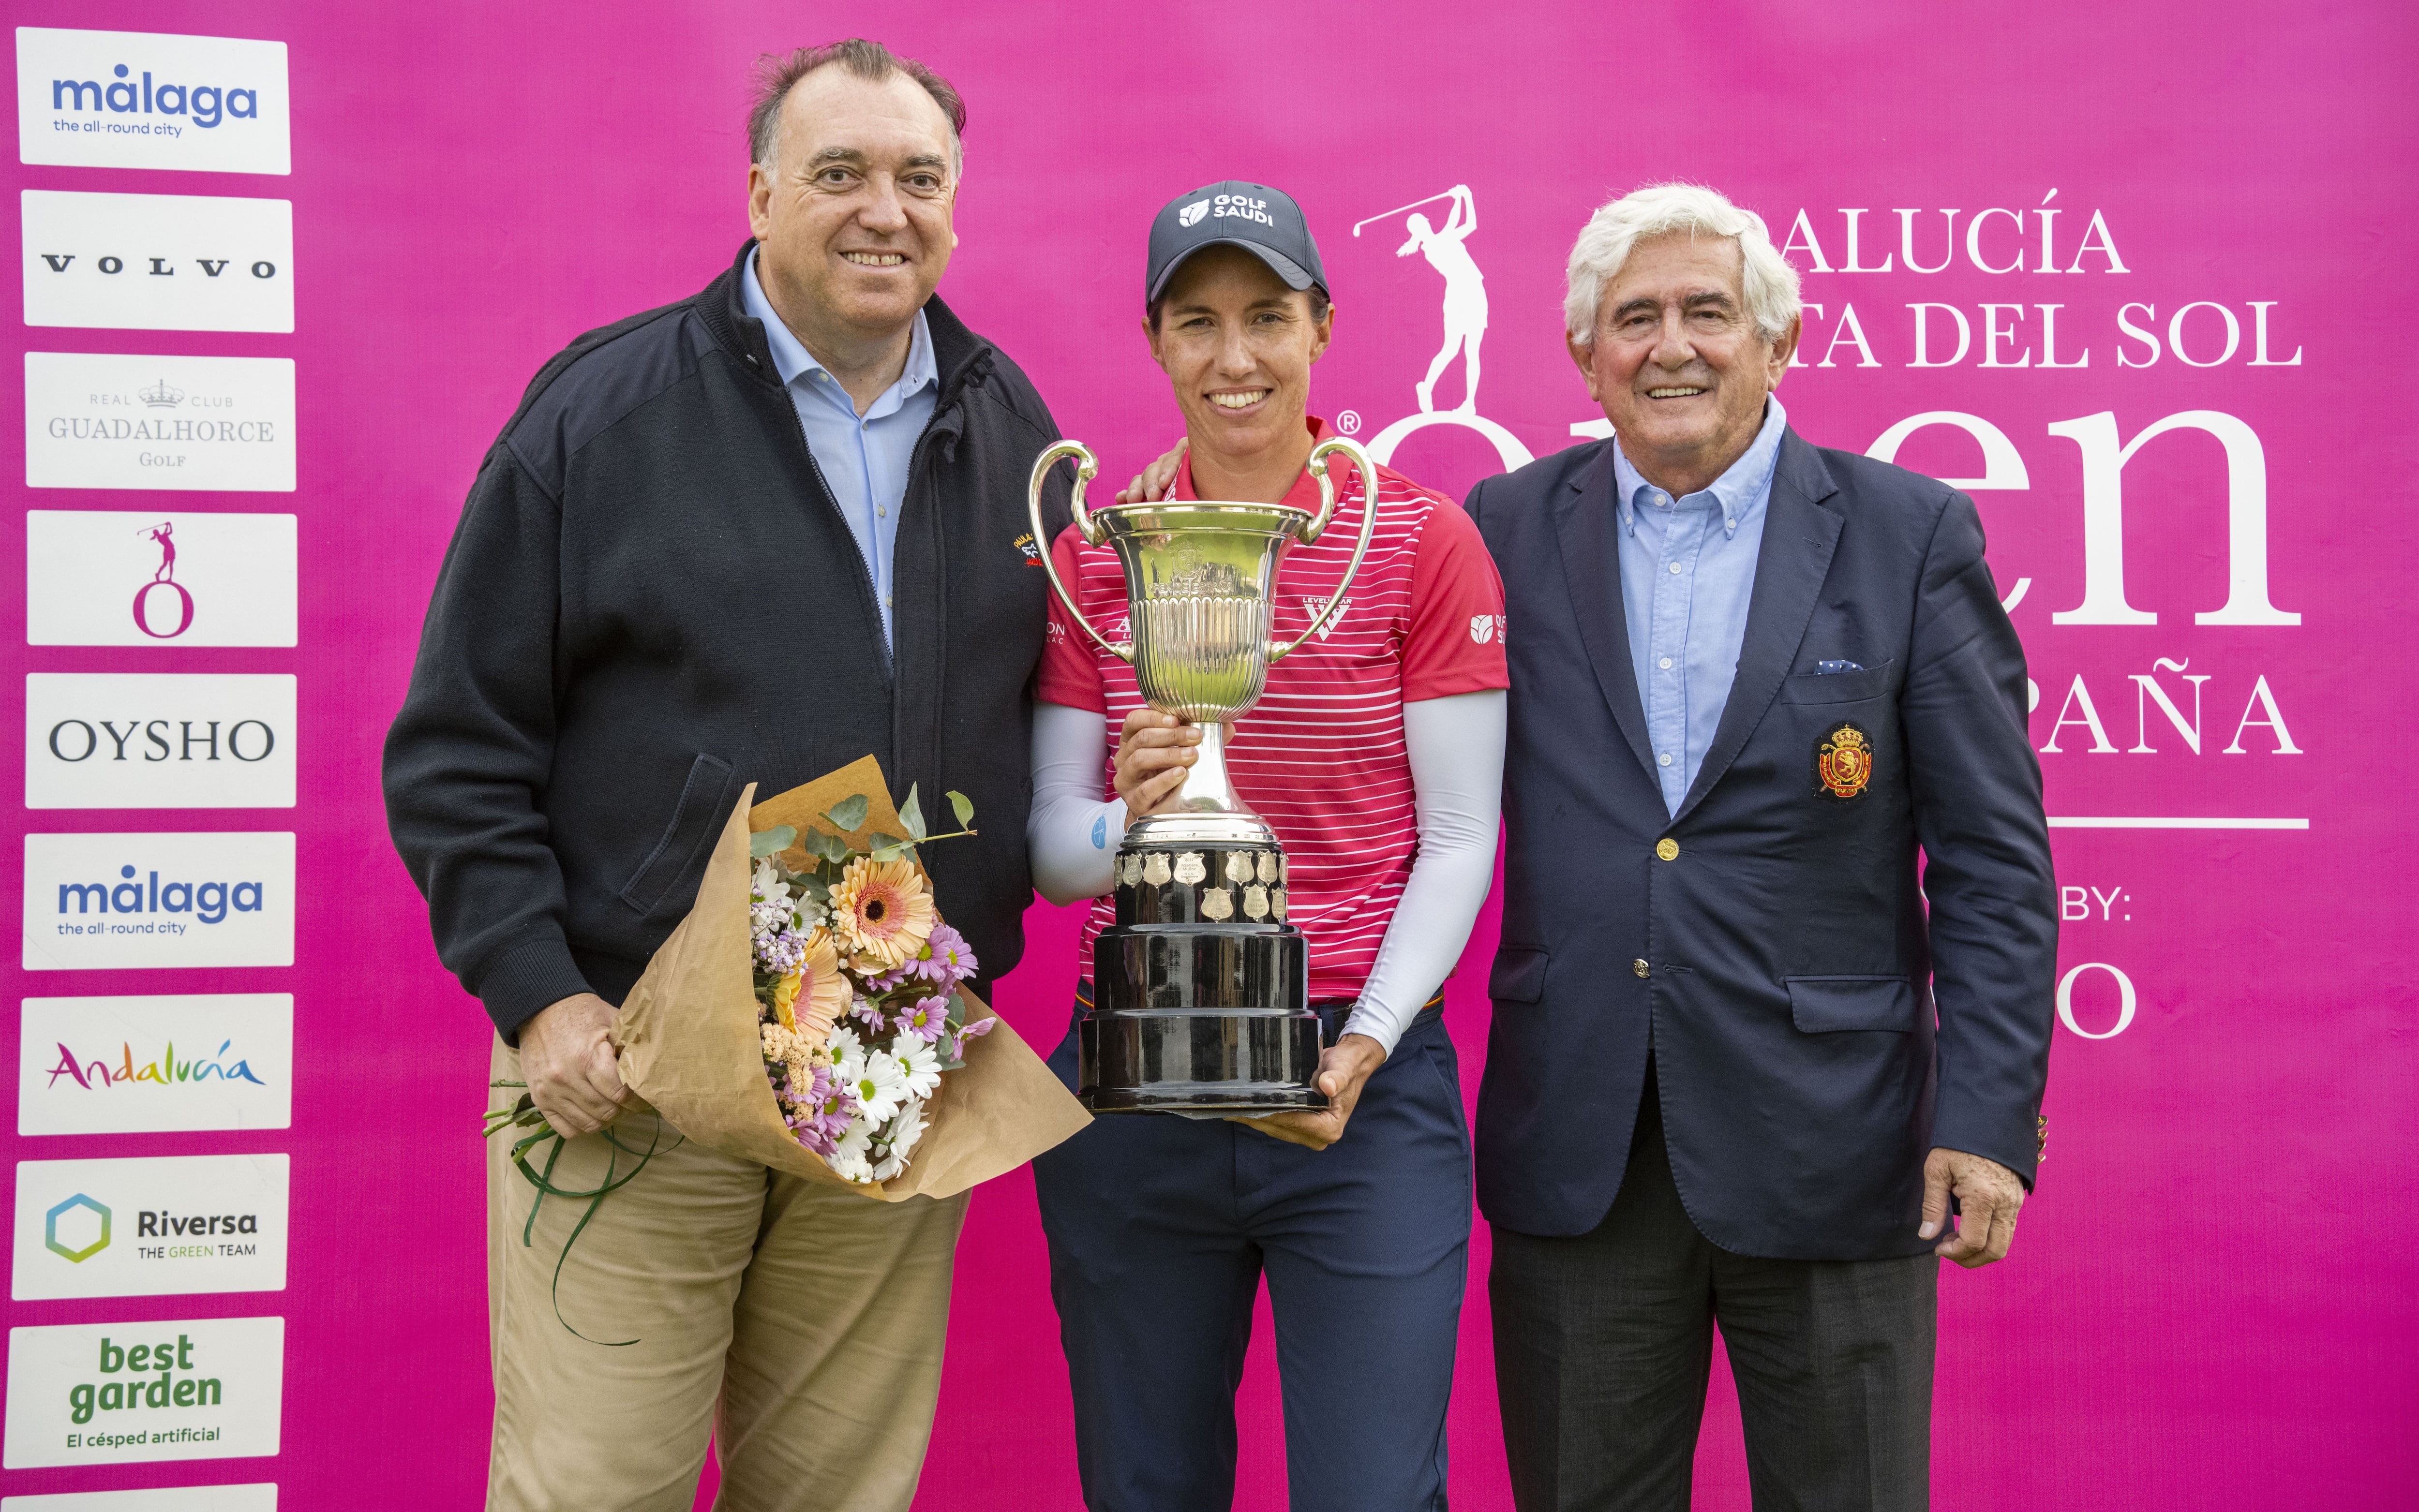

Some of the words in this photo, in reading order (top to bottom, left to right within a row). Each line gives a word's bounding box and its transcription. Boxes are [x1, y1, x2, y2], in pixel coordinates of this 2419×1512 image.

[54, 119, 79, 131] the
[84, 121, 149, 134] all-round
[154, 123, 182, 138] city
[1214, 194, 1267, 210] GOLF
[1213, 206, 1273, 227] SAUDI
[1780, 188, 2131, 274] ALUCÍA
[41, 254, 275, 279] VOLVO
[1906, 303, 2088, 368] DEL
[2117, 301, 2301, 368] SOL
[90, 394, 130, 405] REAL
[192, 397, 232, 407] CLUB
[49, 417, 273, 442] GUADALHORCE
[1147, 582, 1173, 593] OPEN
[1175, 582, 1189, 593] DE
[1192, 580, 1234, 594] ESPAÑA
[49, 720, 274, 762] OYSHO
[2062, 887, 2130, 920] BY:
[58, 923, 83, 934] the
[88, 922, 153, 934] all-round
[159, 921, 186, 935] city
[46, 1039, 266, 1090] Andalucía
[138, 1211, 257, 1237] Riversa
[138, 1247, 164, 1259] THE
[169, 1246, 213, 1258] GREEN
[218, 1244, 255, 1256] TEAM
[100, 1334, 194, 1373] best
[70, 1372, 221, 1424] garden
[67, 1434, 81, 1448] El
[86, 1429, 147, 1448] césped
[151, 1427, 220, 1443] artificial
